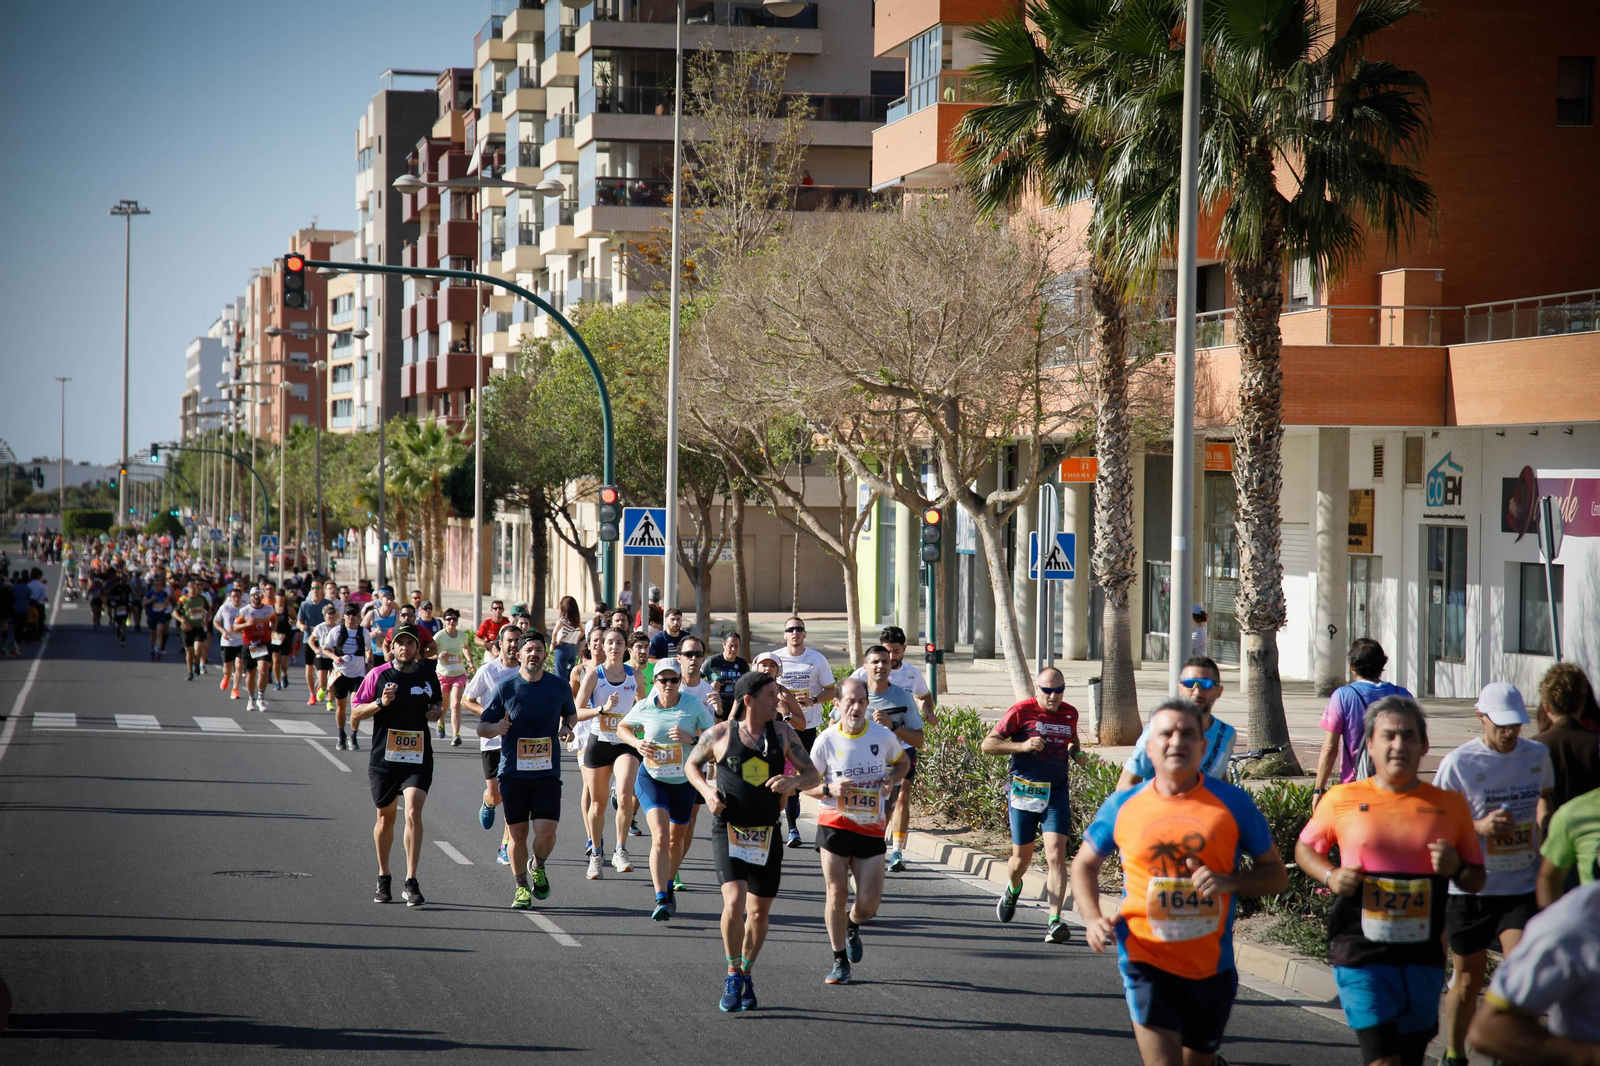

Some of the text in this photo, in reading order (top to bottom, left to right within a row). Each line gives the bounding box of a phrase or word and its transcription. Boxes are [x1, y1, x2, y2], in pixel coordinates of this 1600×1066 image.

[395, 736, 417, 746] 806
[521, 743, 549, 754] 1724
[653, 750, 674, 760] 501
[843, 794, 876, 808] 1146
[733, 828, 767, 843] 1629
[1156, 889, 1215, 909] 1644
[1371, 888, 1425, 910] 1274
